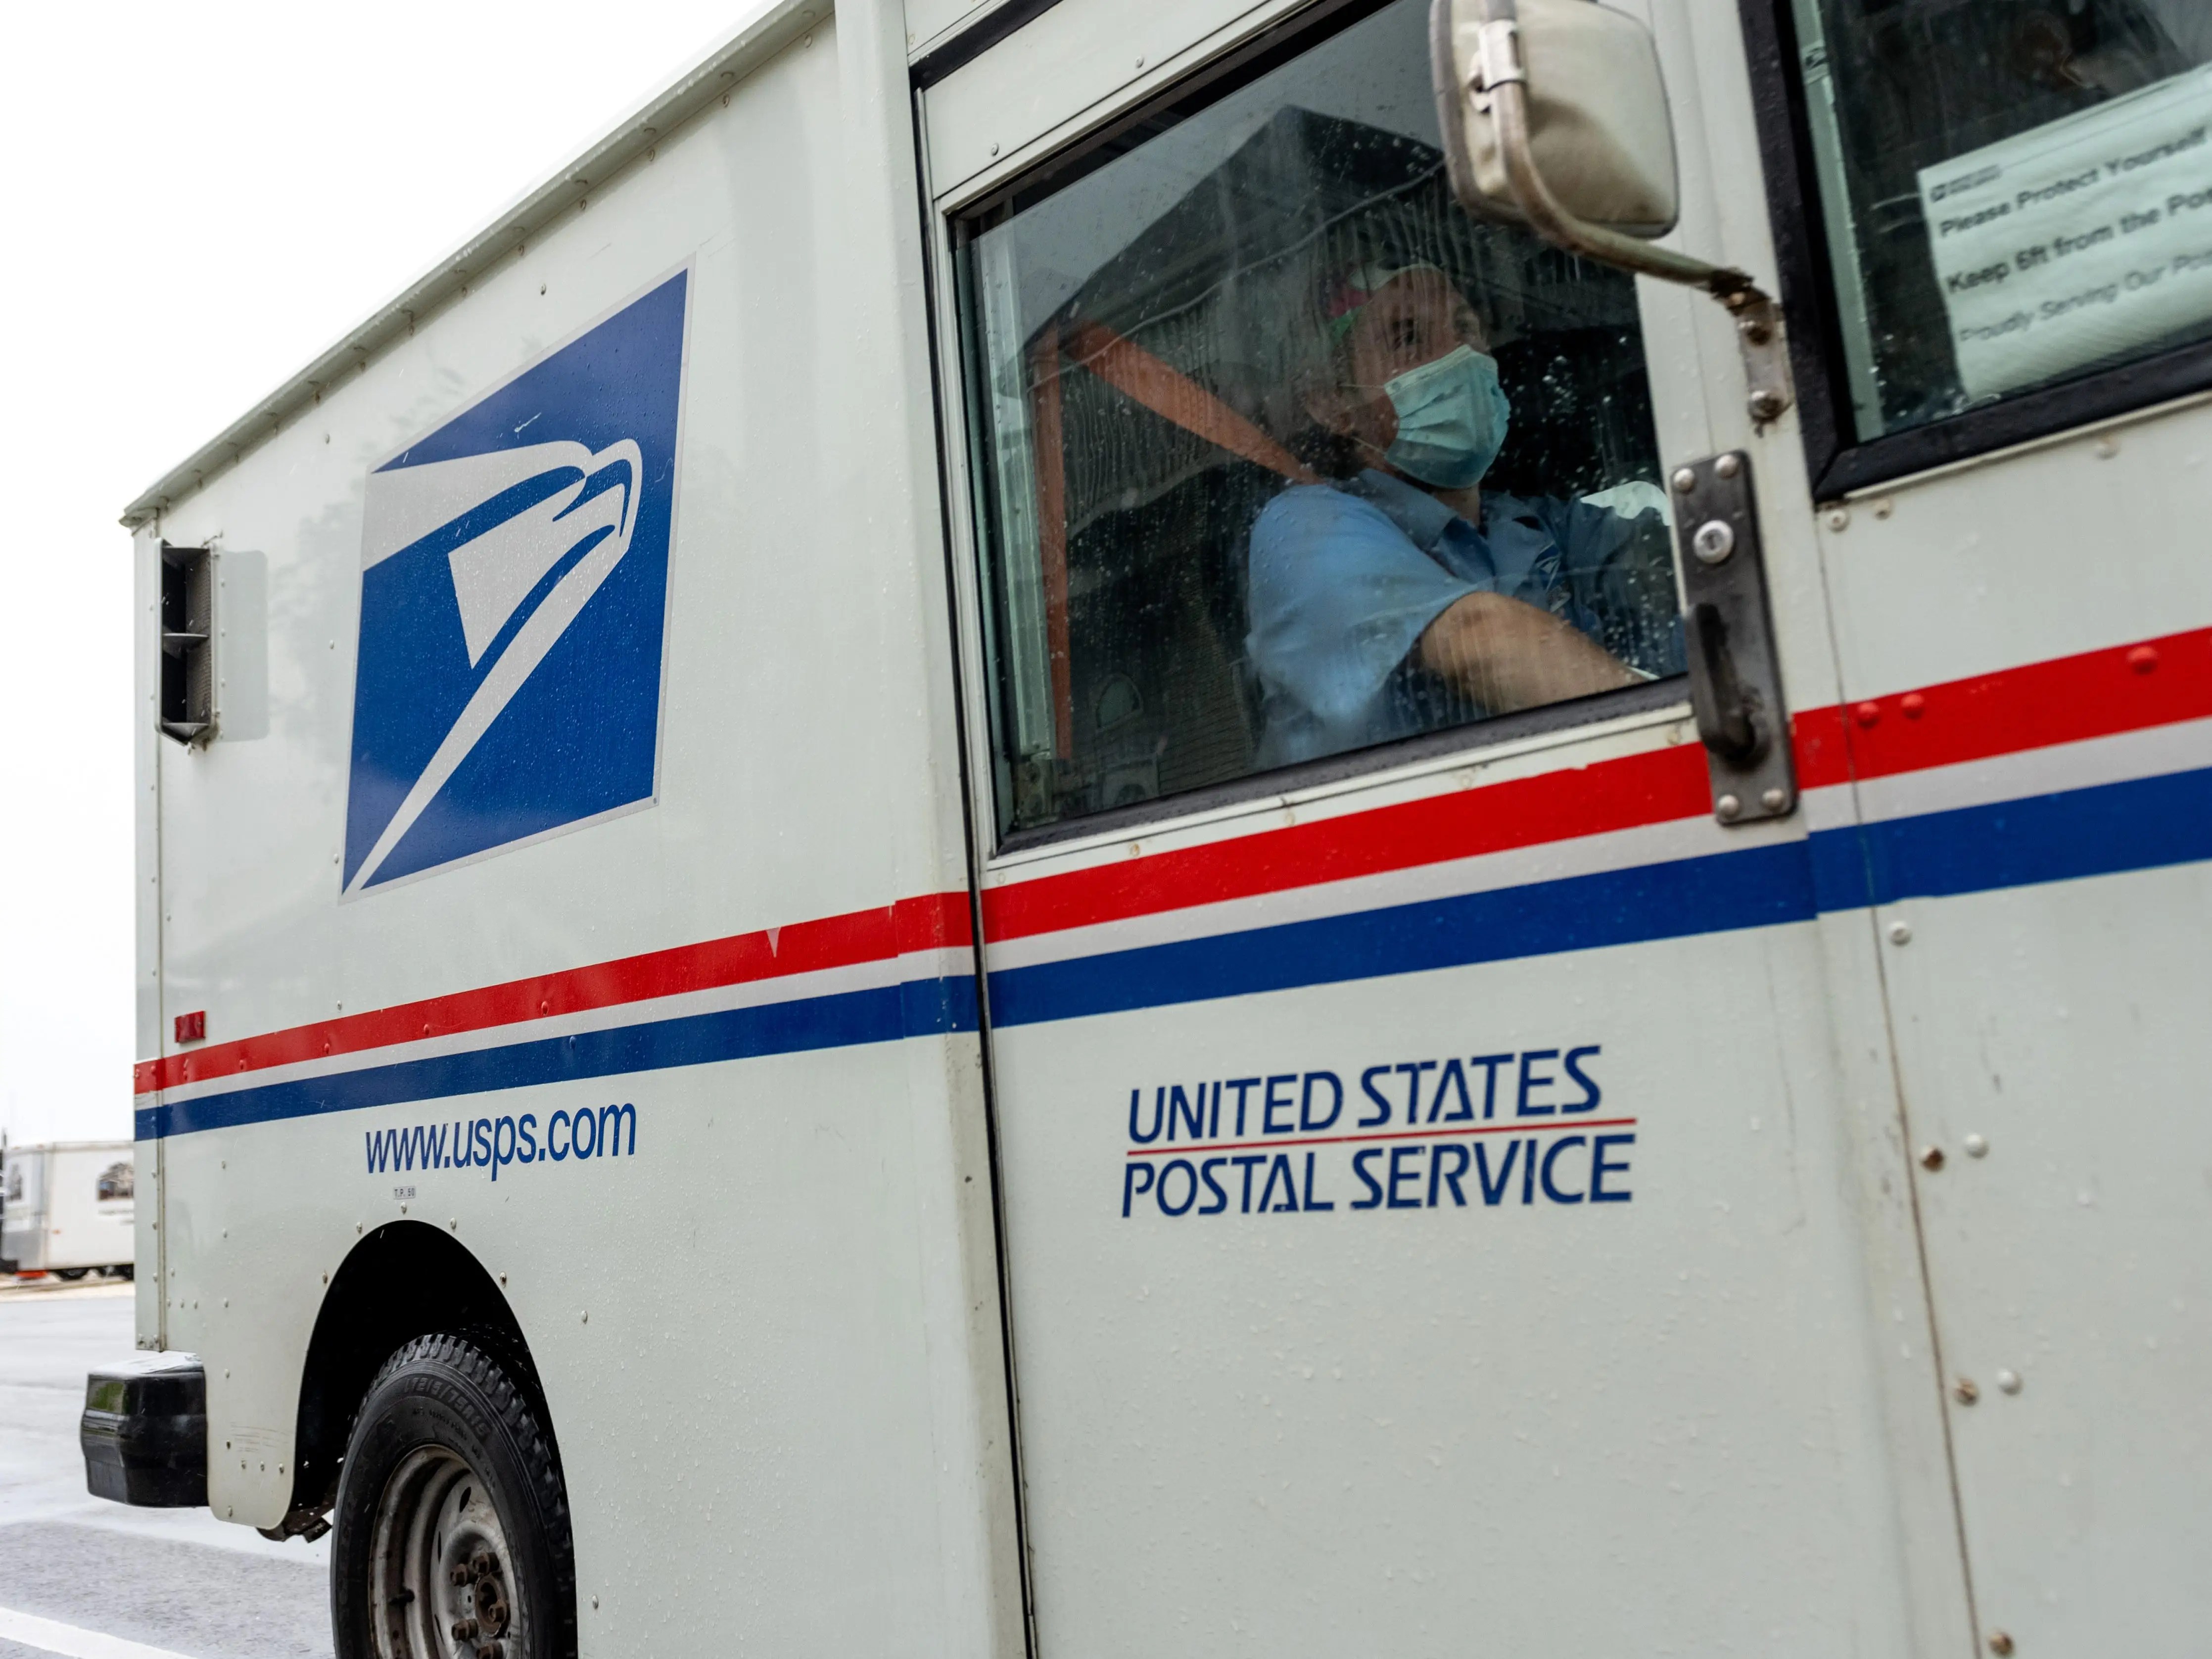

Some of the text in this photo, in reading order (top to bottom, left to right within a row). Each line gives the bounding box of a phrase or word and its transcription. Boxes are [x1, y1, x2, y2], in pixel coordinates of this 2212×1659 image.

[1940, 202, 2010, 237] Please
[2017, 169, 2098, 208] Protect
[1947, 262, 2010, 293] Keep
[2054, 226, 2114, 256] from
[2119, 208, 2159, 234] the
[1129, 1045, 1601, 1143] UNITED STATES
[366, 1103, 636, 1182] www.usps.com
[1122, 1134, 1636, 1218] POSTAL SERVICE
